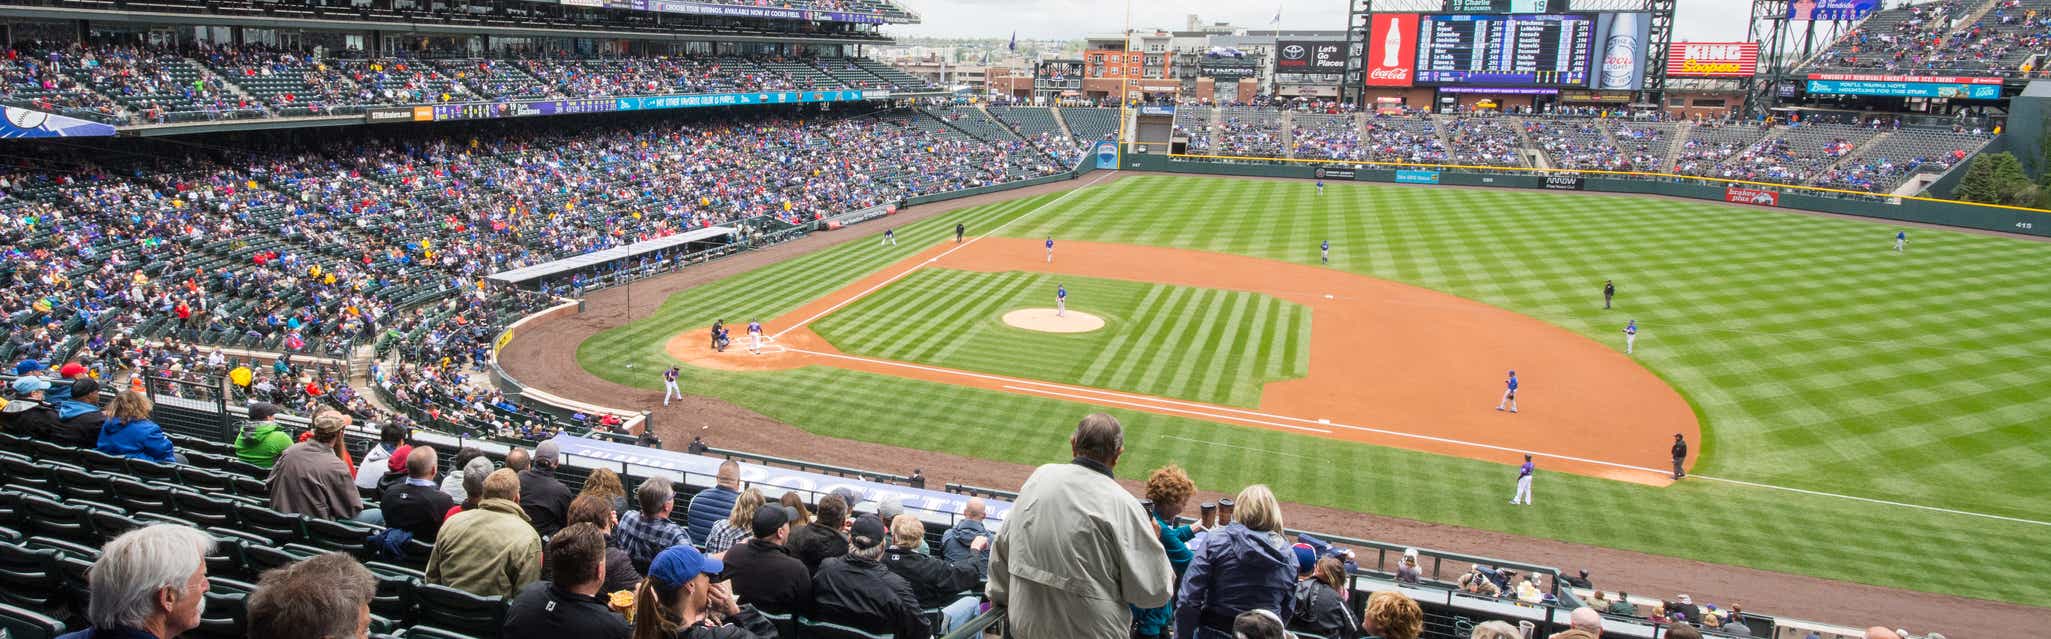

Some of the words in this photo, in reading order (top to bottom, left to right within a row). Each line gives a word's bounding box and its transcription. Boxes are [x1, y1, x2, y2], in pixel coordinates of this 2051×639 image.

[1684, 44, 1741, 60] KING
[1606, 54, 1633, 65] Coors
[1682, 58, 1741, 75] Soopers
[1370, 67, 1408, 79] Coca-Cola
[1546, 177, 1576, 185] ARROW
